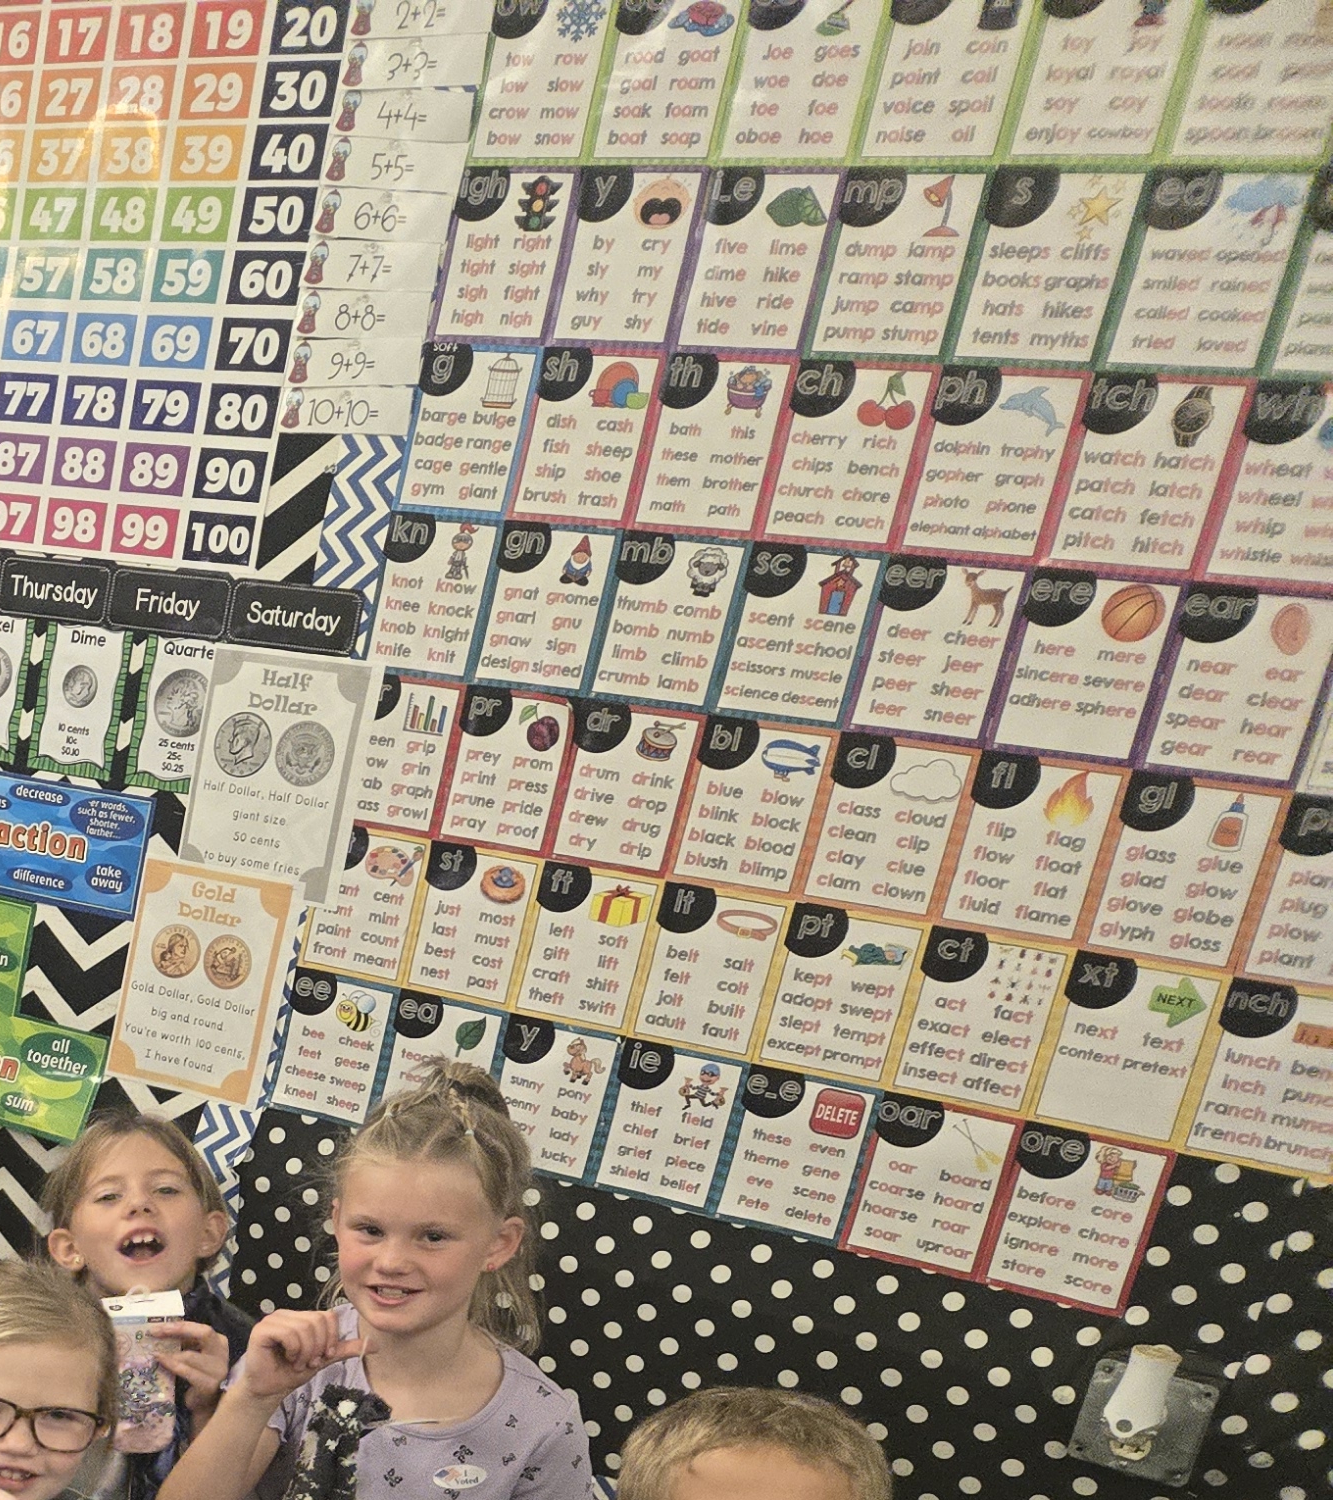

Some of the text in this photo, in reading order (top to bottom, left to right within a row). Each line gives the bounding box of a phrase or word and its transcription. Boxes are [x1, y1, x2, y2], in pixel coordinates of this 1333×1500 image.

[488, 105, 580, 120] crow mow
[307, 398, 379, 427] 10+10=
[542, 438, 633, 461] fish sheep
[54, 504, 96, 541] 98
[121, 512, 168, 550] 99
[189, 521, 251, 556] 100
[10, 573, 98, 609] Thursday
[135, 587, 200, 621] Friday
[246, 601, 342, 635] Saturday
[877, 649, 985, 674] steer jeer
[15, 784, 64, 805] decrease
[13, 868, 66, 891] difference
[1156, 991, 1197, 1009] NEXT
[52, 1038, 71, 1054] all
[26, 1049, 89, 1077] together
[4, 1093, 35, 1113] sum
[283, 1083, 361, 1114] kneel sheep
[815, 1101, 860, 1128] DELETE
[1020, 1131, 1085, 1162] ore
[1001, 1258, 1113, 1295] store score
